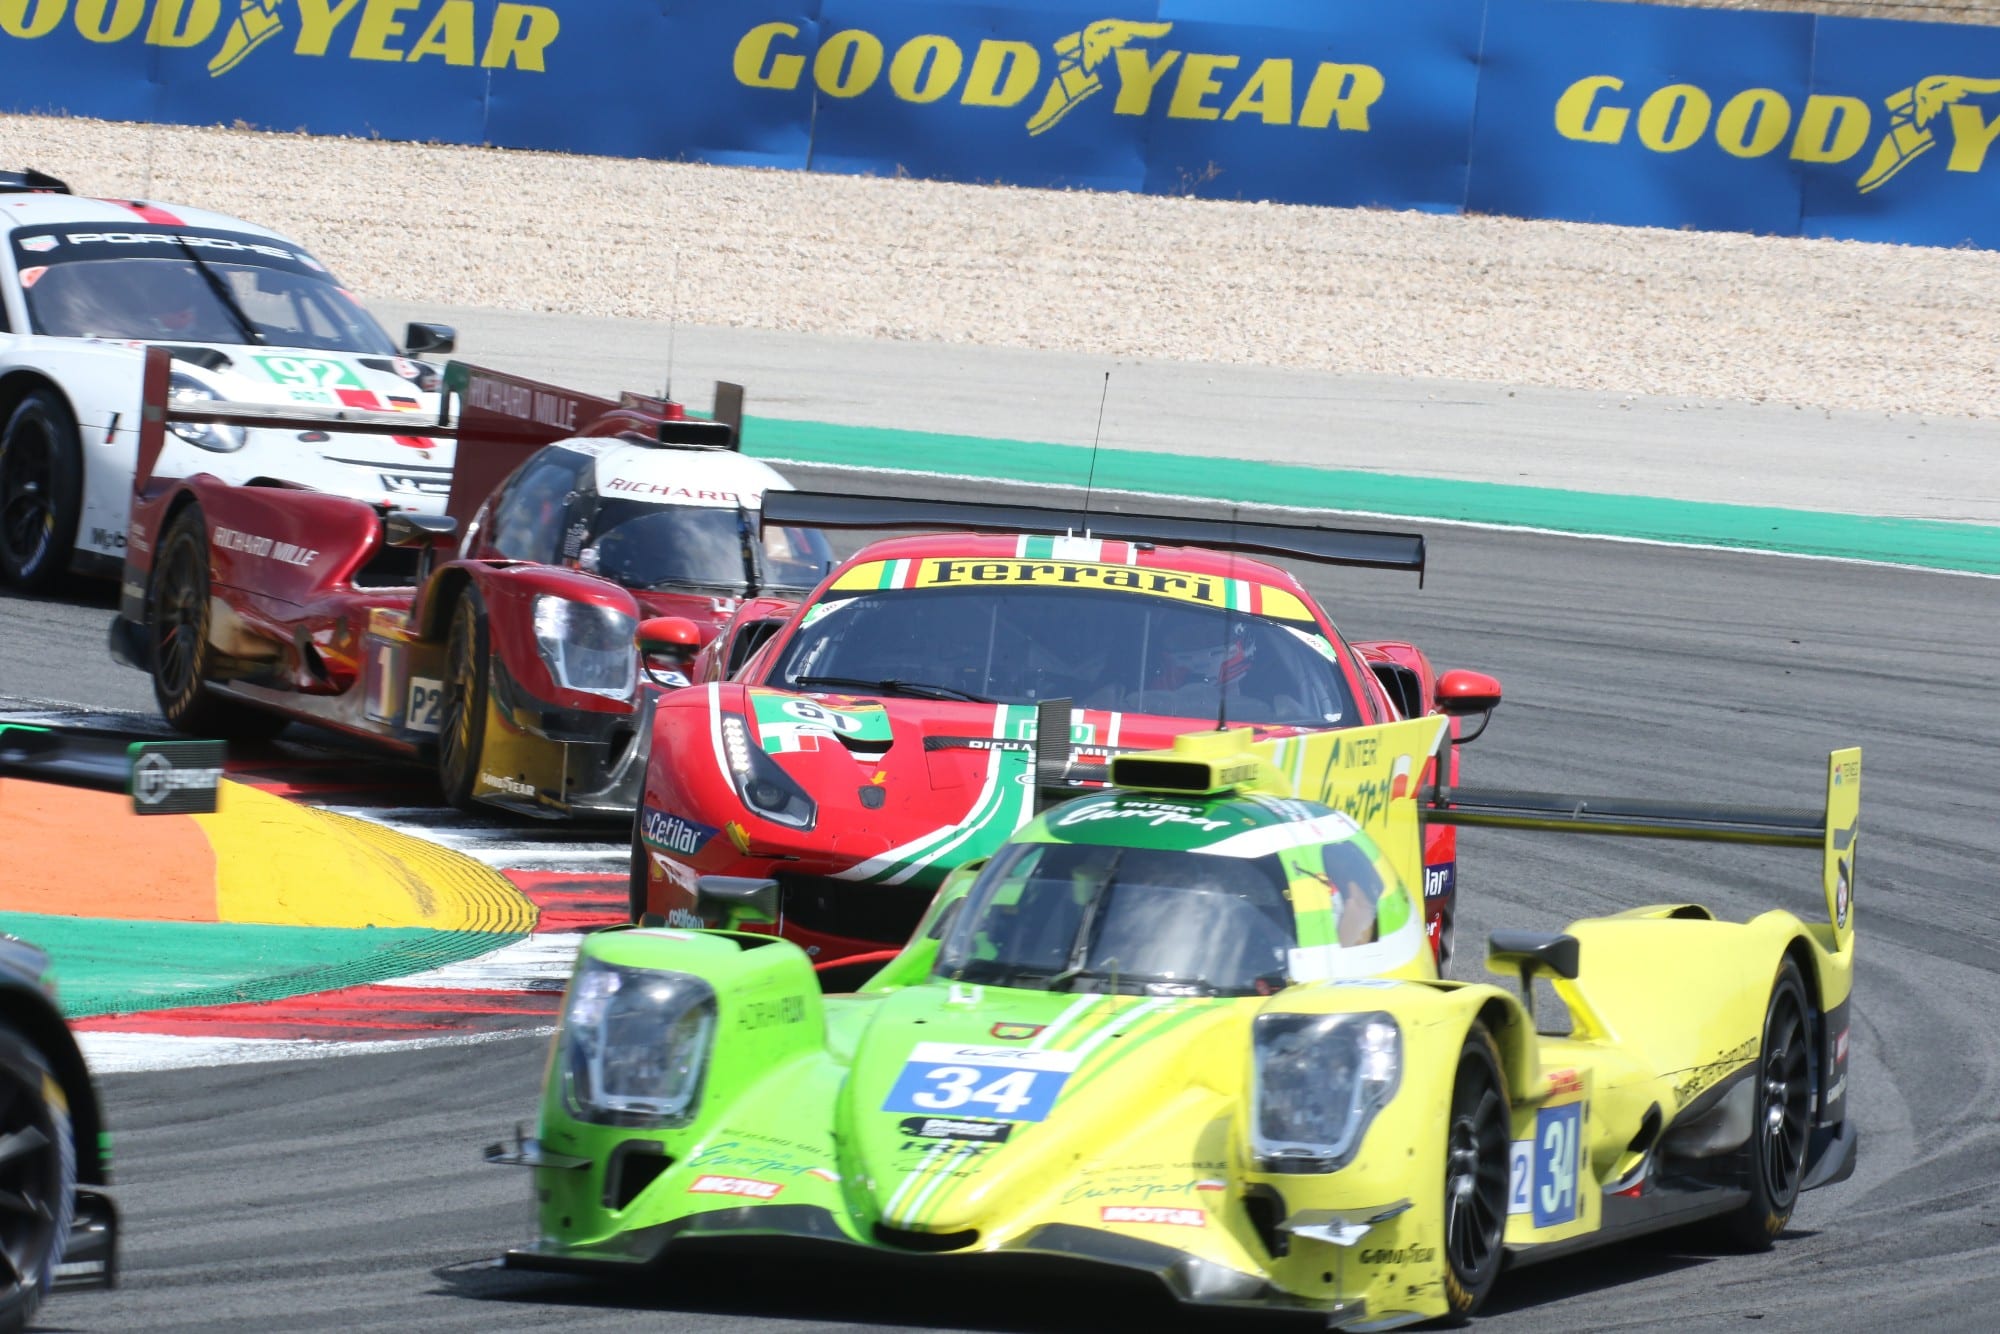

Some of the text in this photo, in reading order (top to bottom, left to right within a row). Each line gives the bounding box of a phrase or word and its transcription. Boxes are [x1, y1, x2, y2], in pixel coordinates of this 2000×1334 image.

[733, 21, 1385, 131] GOODYEAR
[66, 233, 296, 260] PORSCHE
[267, 357, 345, 387] 92
[468, 375, 578, 431] RICHARD MILLE
[606, 477, 739, 502] RICHARD
[213, 526, 320, 567] RICHARD MILLE
[927, 560, 1214, 602] Ferrari
[411, 686, 442, 725] P2
[796, 702, 848, 730] 51
[1122, 801, 1195, 815] INTER
[649, 812, 702, 854] Cetilar
[912, 1066, 1039, 1114] 34
[1540, 1117, 1576, 1214] 34
[690, 1175, 779, 1198] MOTUL
[1103, 1206, 1205, 1227] MOTUL
